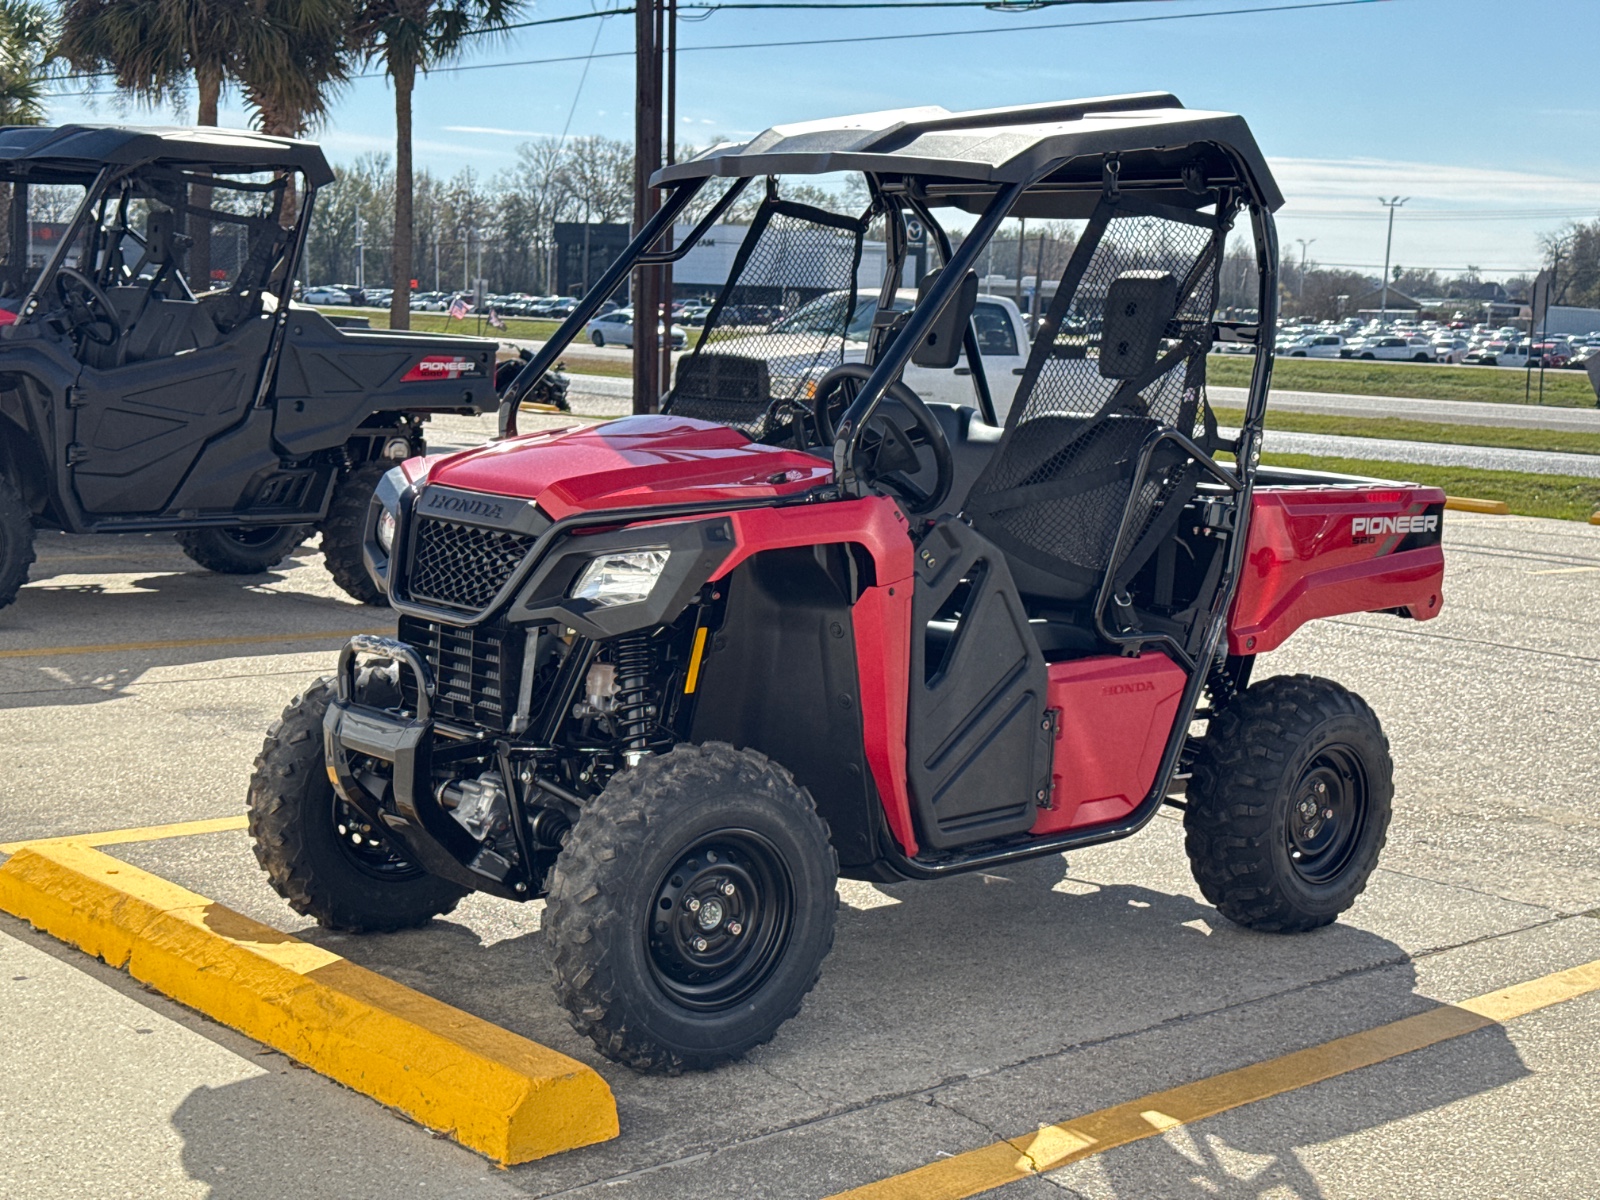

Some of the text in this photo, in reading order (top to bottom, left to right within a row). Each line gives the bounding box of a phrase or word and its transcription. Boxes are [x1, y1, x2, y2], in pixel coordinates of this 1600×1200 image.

[419, 362, 475, 371] PIONEER
[428, 494, 504, 518] HONDA
[1351, 515, 1438, 535] PIONEER
[1352, 536, 1375, 544] 520
[1101, 681, 1155, 696] HONDA
